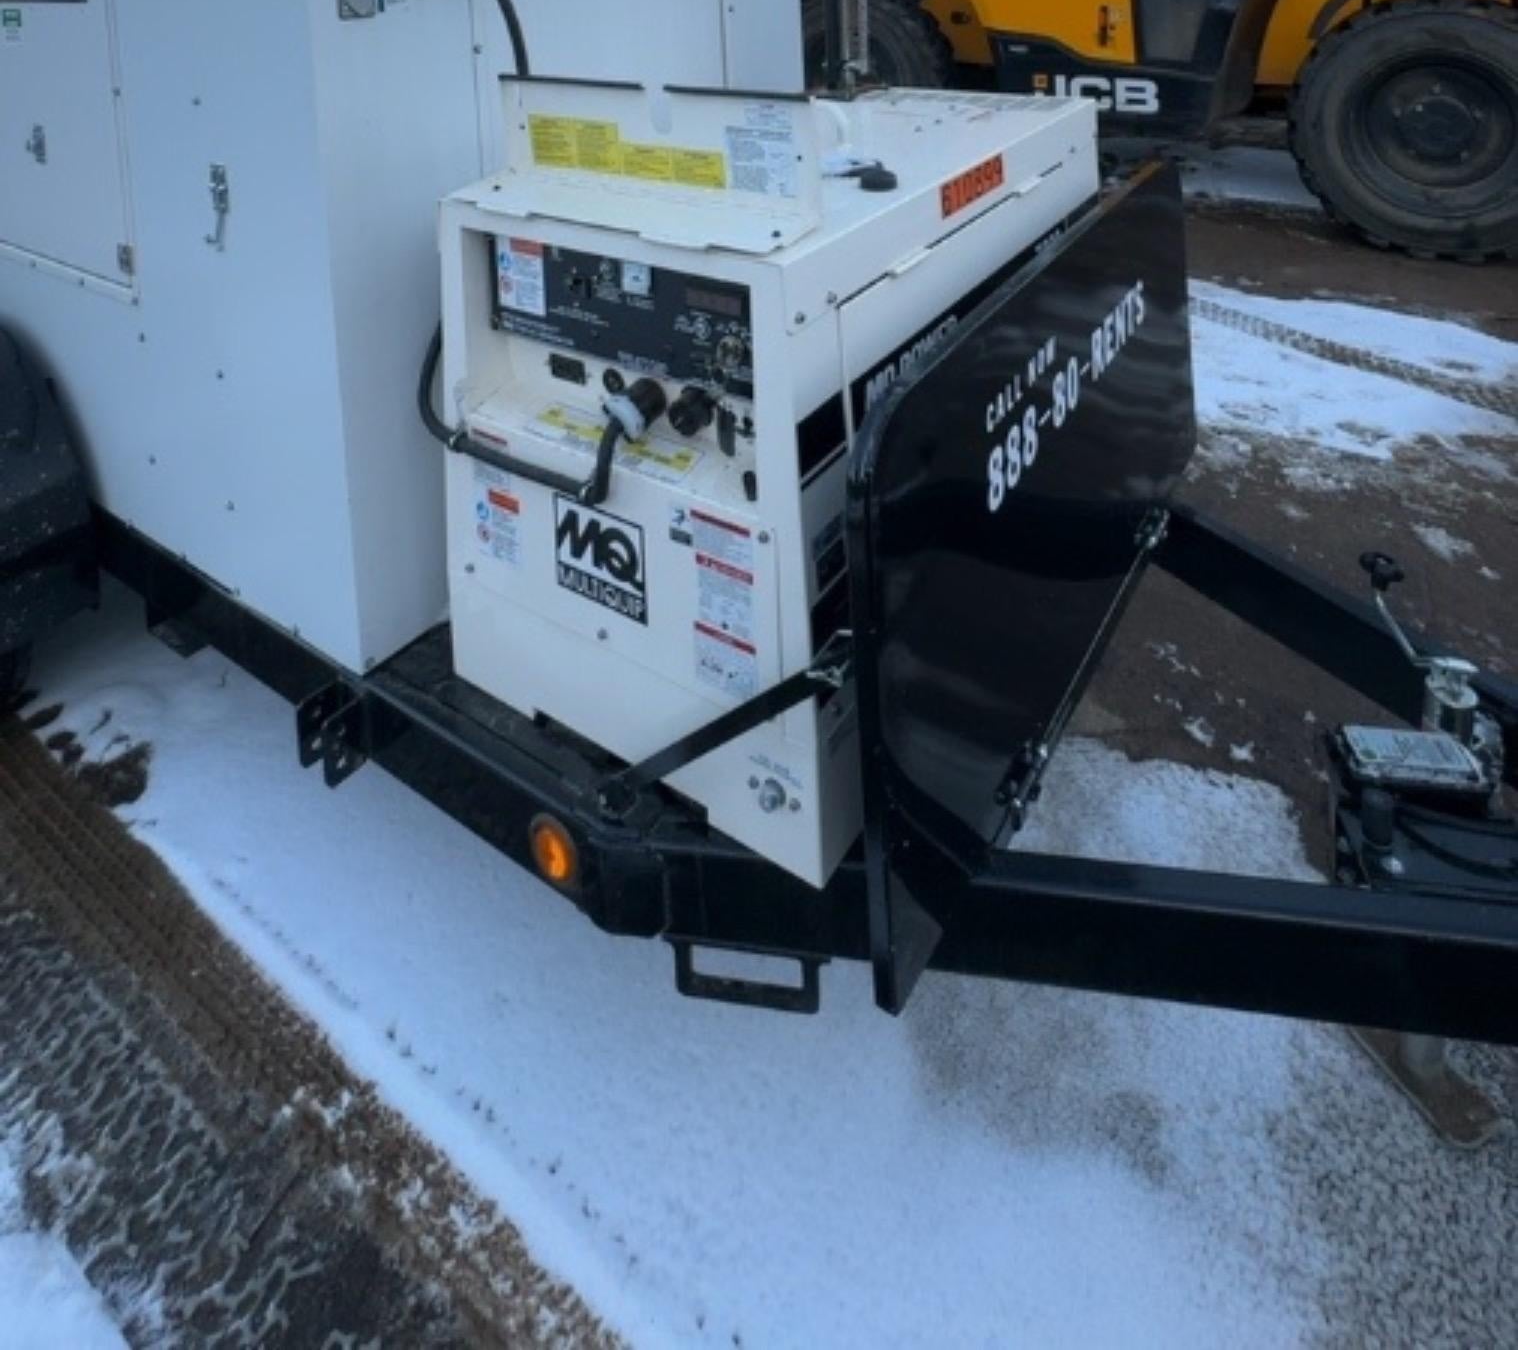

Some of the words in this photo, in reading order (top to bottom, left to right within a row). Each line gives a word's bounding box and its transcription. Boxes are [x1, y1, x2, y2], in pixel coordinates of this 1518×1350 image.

[1034, 73, 1160, 112] JCB
[986, 374, 1022, 433] CALL
[1027, 335, 1057, 388] NOW
[986, 279, 1146, 513] 888-80-RENTS
[557, 508, 645, 592] MQ
[559, 564, 642, 620] MULTIQUIP
